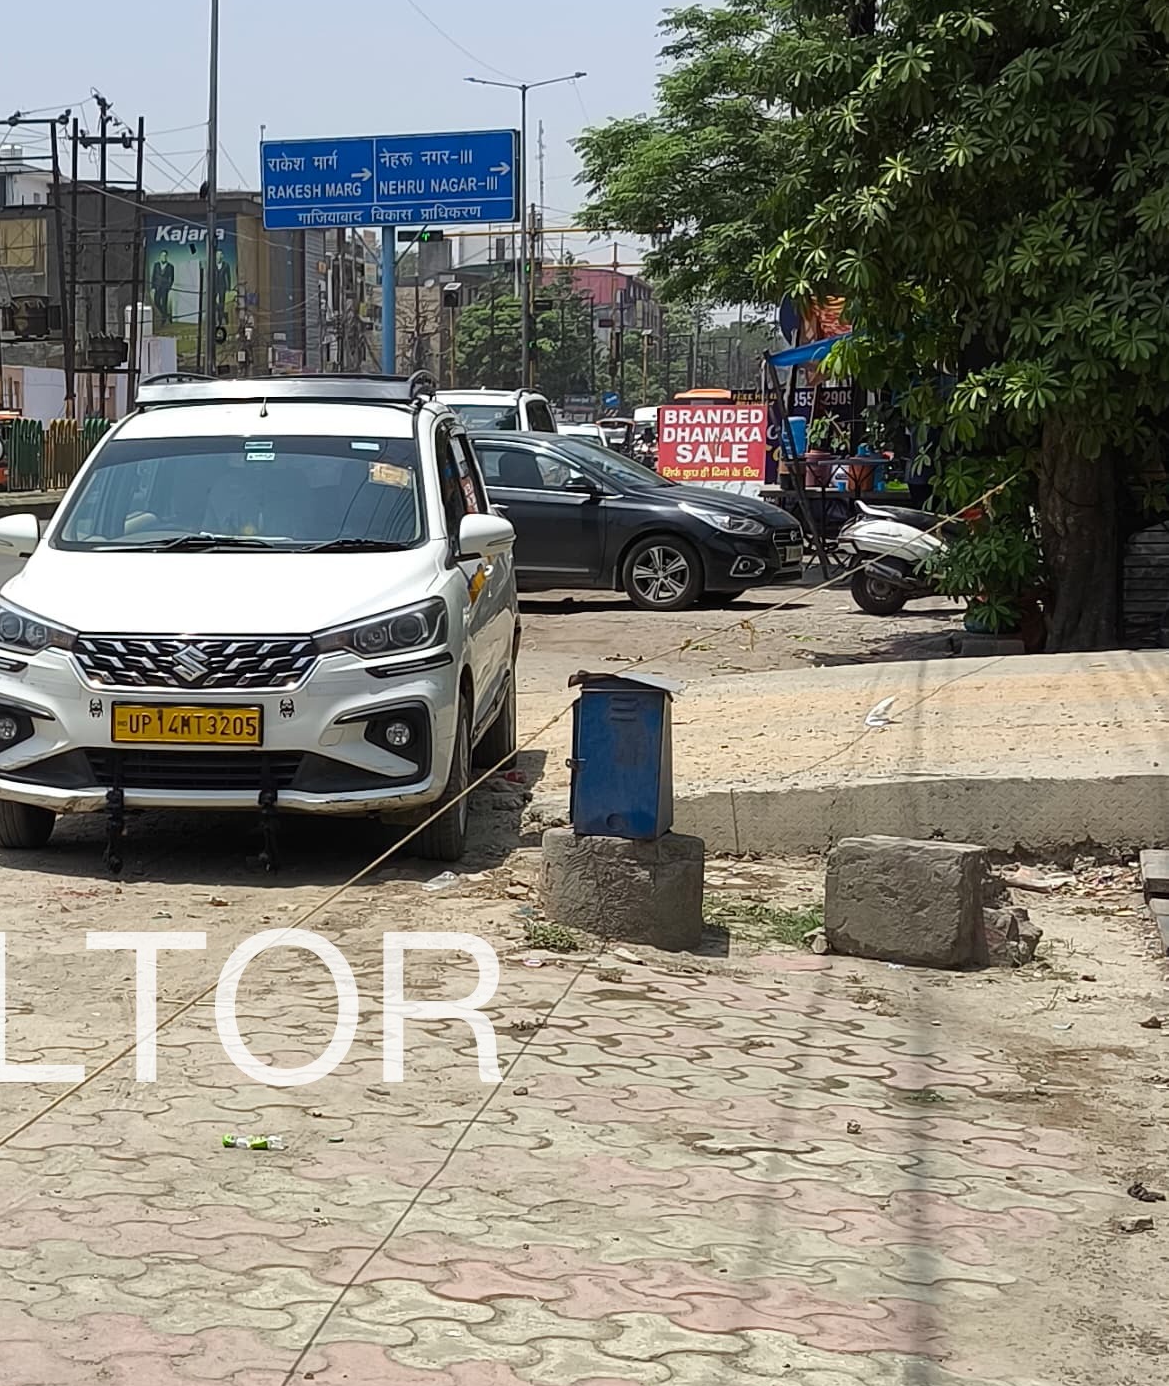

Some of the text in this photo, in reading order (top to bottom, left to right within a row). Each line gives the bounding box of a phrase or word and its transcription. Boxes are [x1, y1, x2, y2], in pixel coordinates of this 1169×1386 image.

[267, 149, 338, 172] राकेश मार्ग
[379, 148, 413, 168] नेहरू
[267, 181, 362, 200] RAKESH MARG
[380, 175, 498, 196] NEHRU NAGAR-III
[297, 203, 482, 225] गाजियाबाद विकास प्राधिकरण
[155, 225, 225, 245] Kajara
[664, 409, 763, 425] BRANDED
[663, 426, 762, 443] DHAMAKA
[676, 444, 749, 463] SALE
